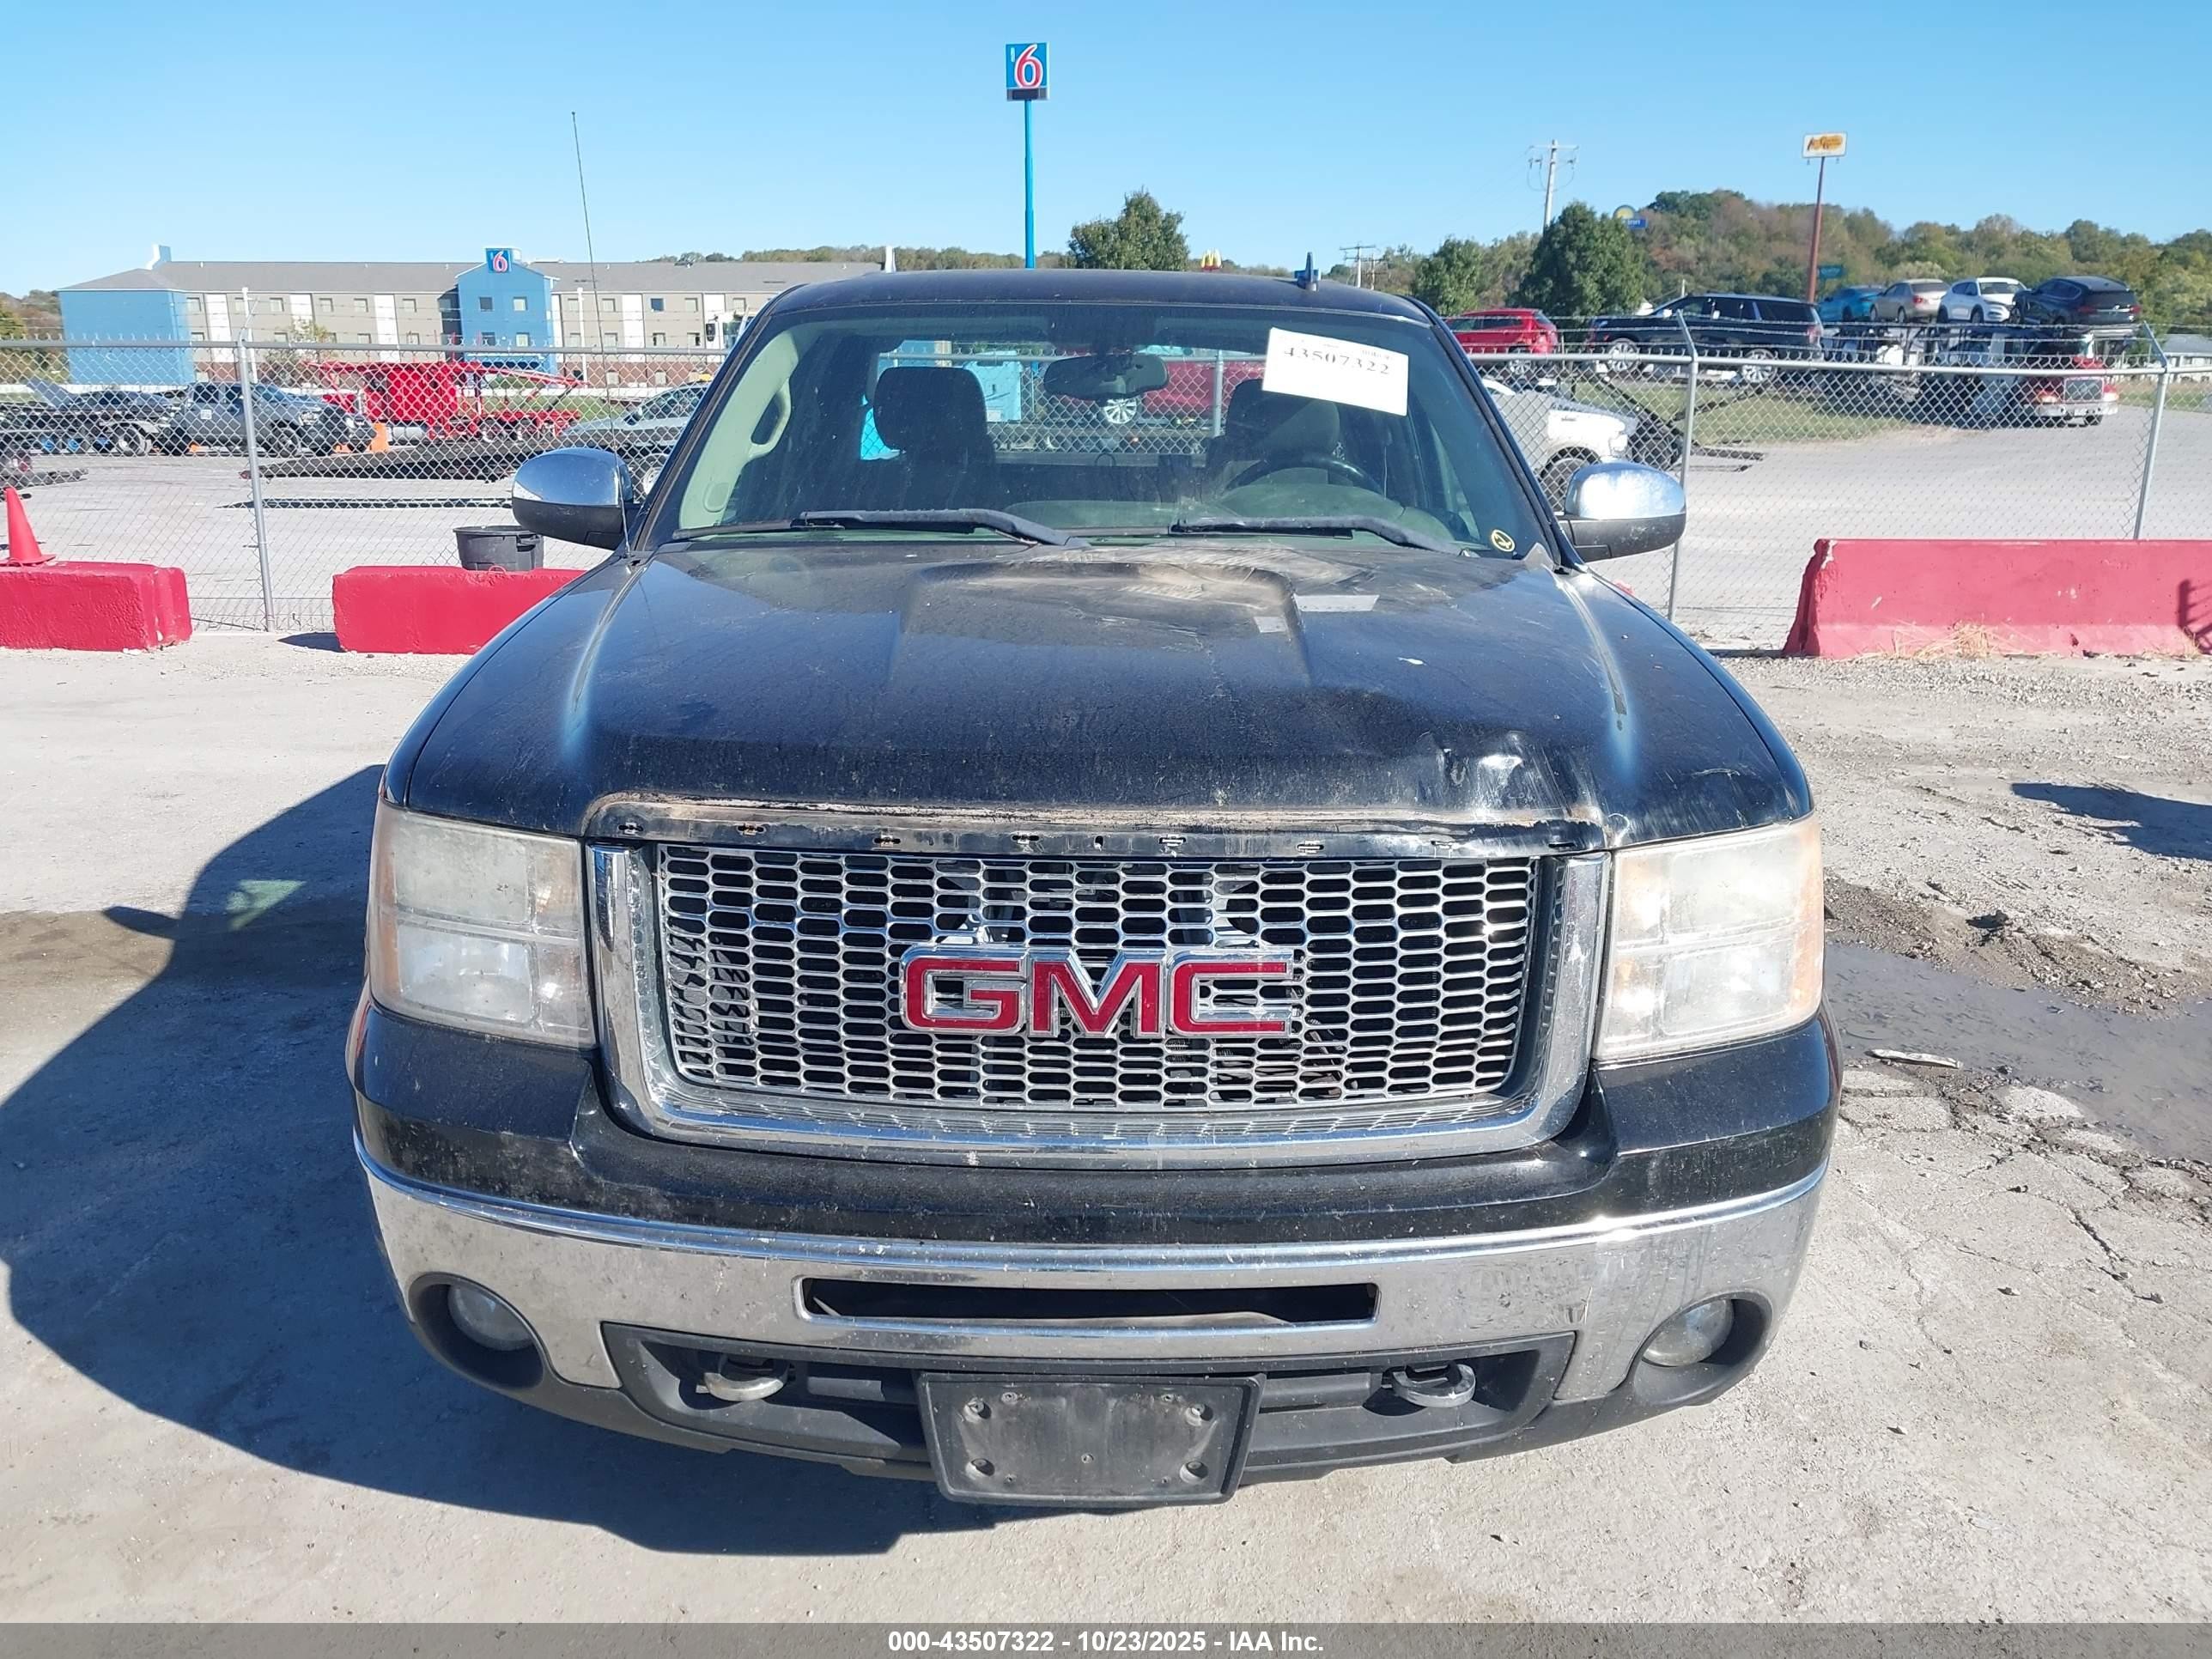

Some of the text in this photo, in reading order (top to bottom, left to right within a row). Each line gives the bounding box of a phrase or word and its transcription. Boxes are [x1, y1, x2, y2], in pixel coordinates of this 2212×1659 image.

[1014, 43, 1044, 89] 6
[492, 250, 508, 273] 6
[1284, 346, 1390, 375] 43507322
[900, 944, 1295, 1038] GMC
